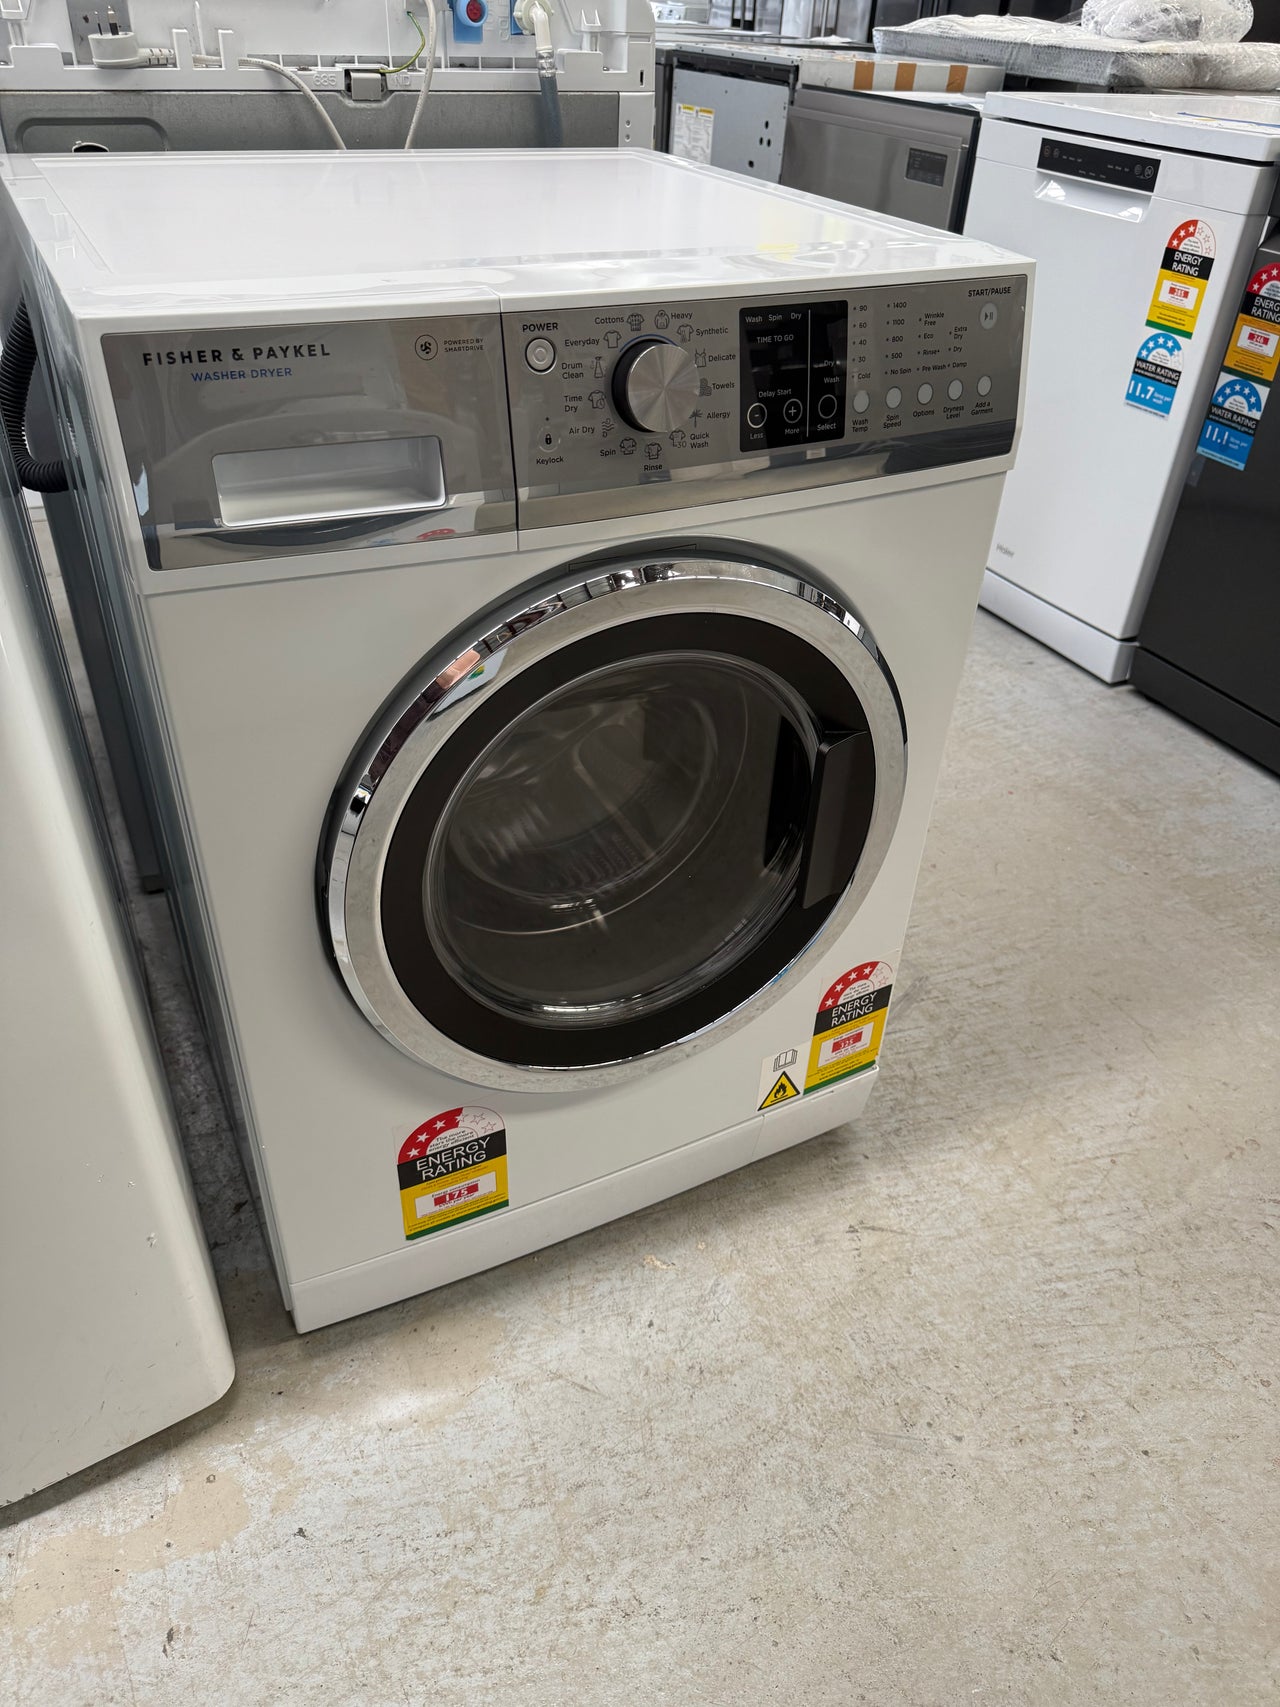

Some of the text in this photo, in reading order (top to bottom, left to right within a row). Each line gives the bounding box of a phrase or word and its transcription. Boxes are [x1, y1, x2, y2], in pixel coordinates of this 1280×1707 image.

[313, 72, 337, 86] 685
[1174, 252, 1203, 266] ENERGY
[1172, 262, 1199, 276] RATING
[968, 287, 1011, 297] START/PAUSE
[1254, 296, 1280, 312] ENERG
[671, 312, 692, 320] Heavy
[768, 314, 782, 322] Spin
[790, 312, 802, 320] Dry
[1251, 306, 1280, 322] RATING
[595, 316, 624, 325] Cottons
[745, 315, 762, 323] Wash
[522, 322, 558, 332] POWER
[696, 327, 728, 336] Synthetic
[564, 338, 600, 347] Everyday
[143, 344, 330, 366] FISHER & PAYKEL
[708, 354, 736, 362] Delicate
[562, 362, 582, 370] Drum
[932, 363, 946, 371] Wash
[952, 361, 967, 369] Damp
[191, 367, 292, 382] WASHER DRYER
[900, 367, 912, 375] Spin
[1136, 360, 1180, 381] WATER RATING
[824, 376, 840, 384] Wash
[712, 381, 735, 390] Towels
[1128, 380, 1154, 400] 11.7
[759, 388, 792, 398] Delay Start
[564, 405, 578, 413] Dry
[913, 409, 934, 418] Options
[943, 405, 964, 414] Dryness
[971, 408, 993, 416] Garment
[707, 411, 731, 419] Allergy
[886, 414, 899, 422] Spin
[946, 412, 960, 420] Level
[1212, 406, 1257, 429] WATER RATING
[817, 423, 836, 431] Select
[883, 420, 902, 429] Speed
[582, 426, 595, 434] Dry
[690, 432, 710, 441] Quick
[1206, 425, 1229, 445] 11.1
[690, 440, 709, 448] Wash
[600, 449, 616, 457] Spin
[536, 457, 564, 465] Keylock
[644, 463, 662, 471] Rinse
[832, 992, 877, 1017] ENERGY
[832, 1004, 873, 1027] RATING
[416, 1137, 490, 1171] ENERGY
[422, 1151, 486, 1180] RATING
[446, 1188, 468, 1201] 175
